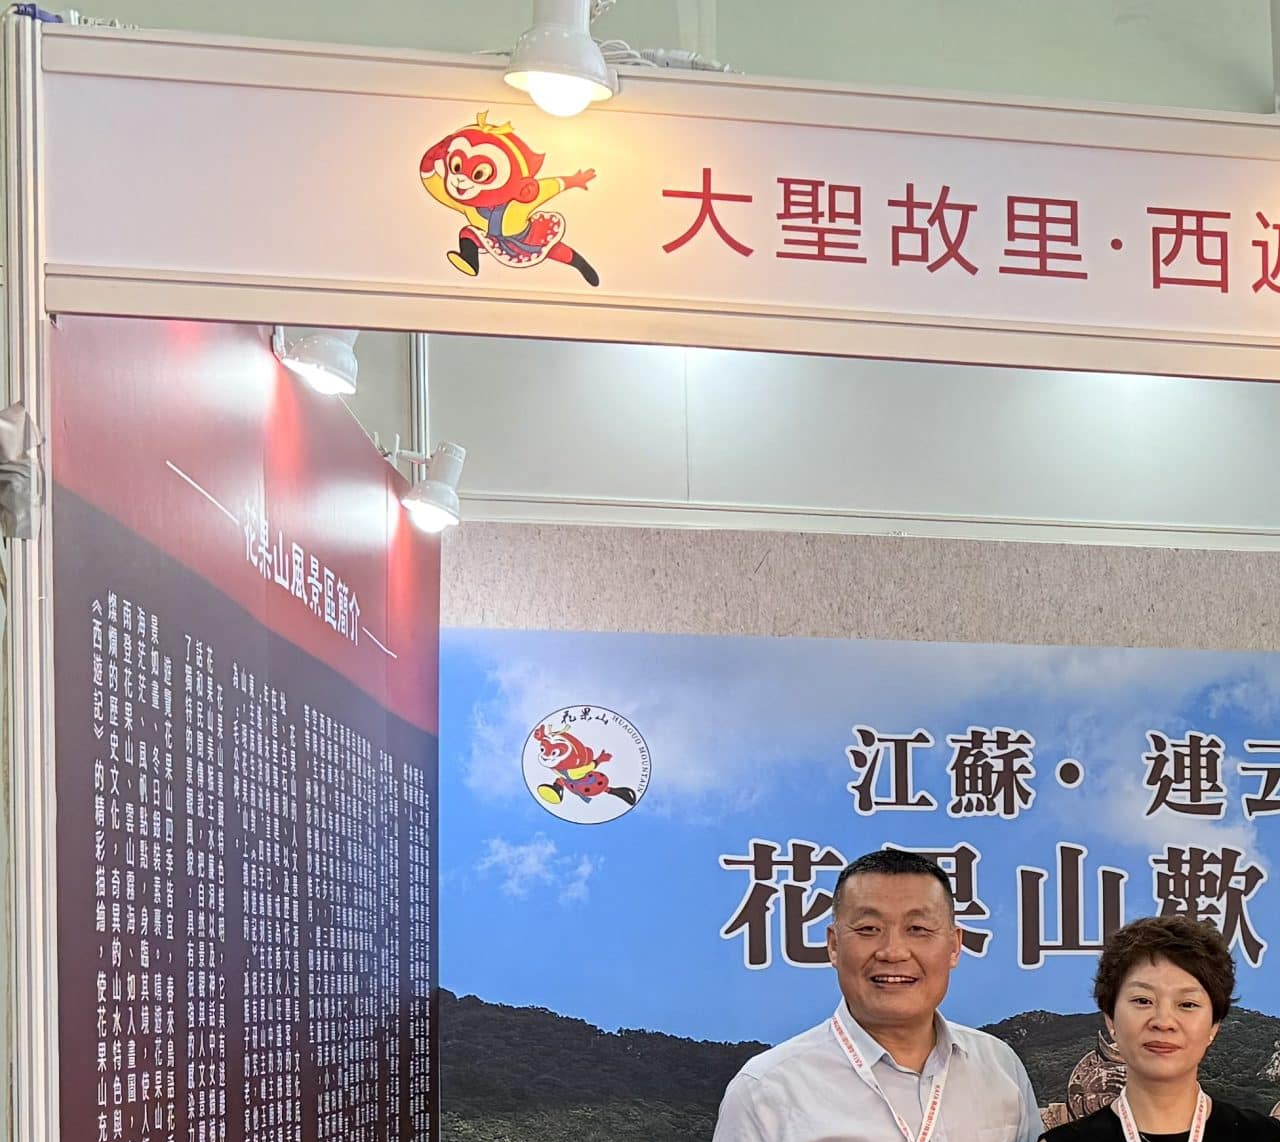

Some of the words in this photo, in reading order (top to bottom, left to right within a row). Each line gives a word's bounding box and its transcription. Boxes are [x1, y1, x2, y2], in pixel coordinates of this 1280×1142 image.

[244, 501, 361, 646] 花果山風景區簡介
